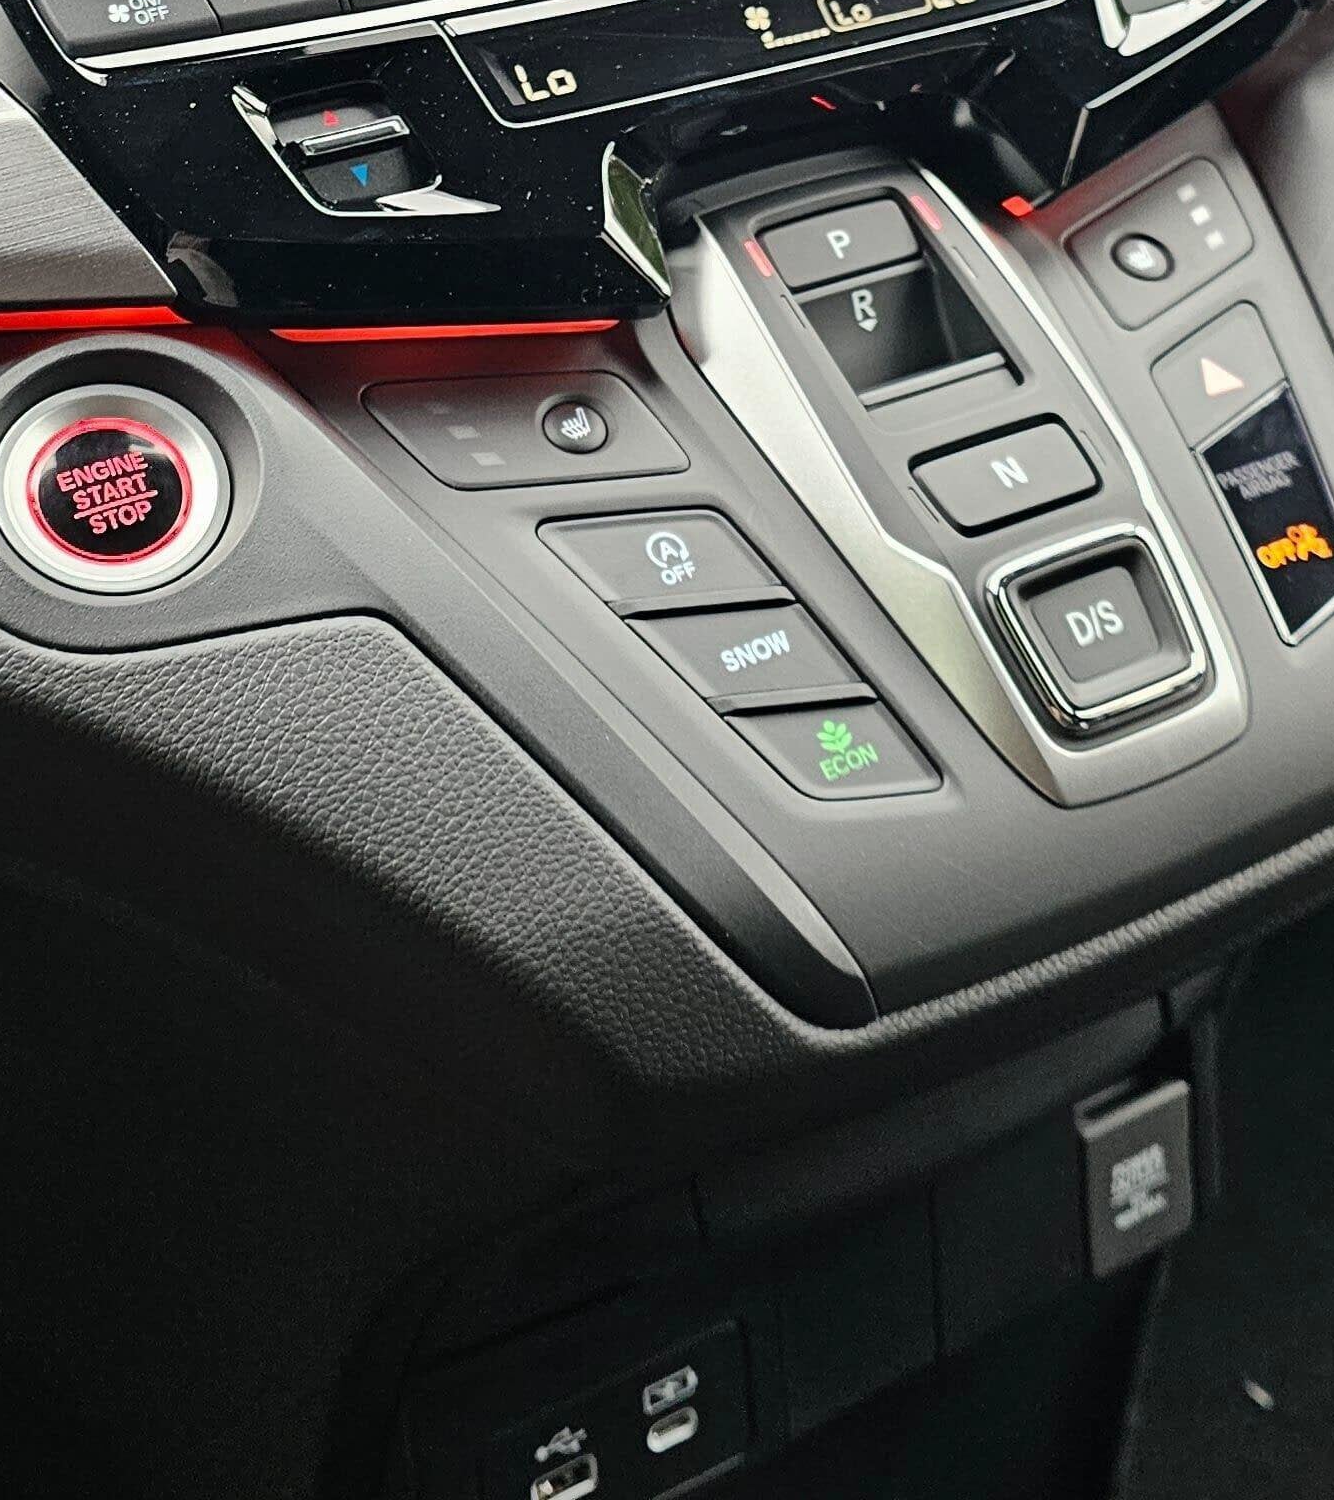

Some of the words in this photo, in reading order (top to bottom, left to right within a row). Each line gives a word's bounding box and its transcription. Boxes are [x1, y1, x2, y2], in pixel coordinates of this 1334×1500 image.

[134, 4, 170, 26] OFF
[826, 229, 852, 260] P
[851, 288, 875, 322] R
[56, 451, 149, 493] ENGINE
[991, 456, 1030, 489] N
[72, 472, 148, 510] START
[89, 500, 152, 535] STOP
[661, 562, 696, 586] OFF
[1066, 599, 1125, 647] D/S
[721, 630, 791, 672] SNOW
[819, 744, 879, 781] ECON
